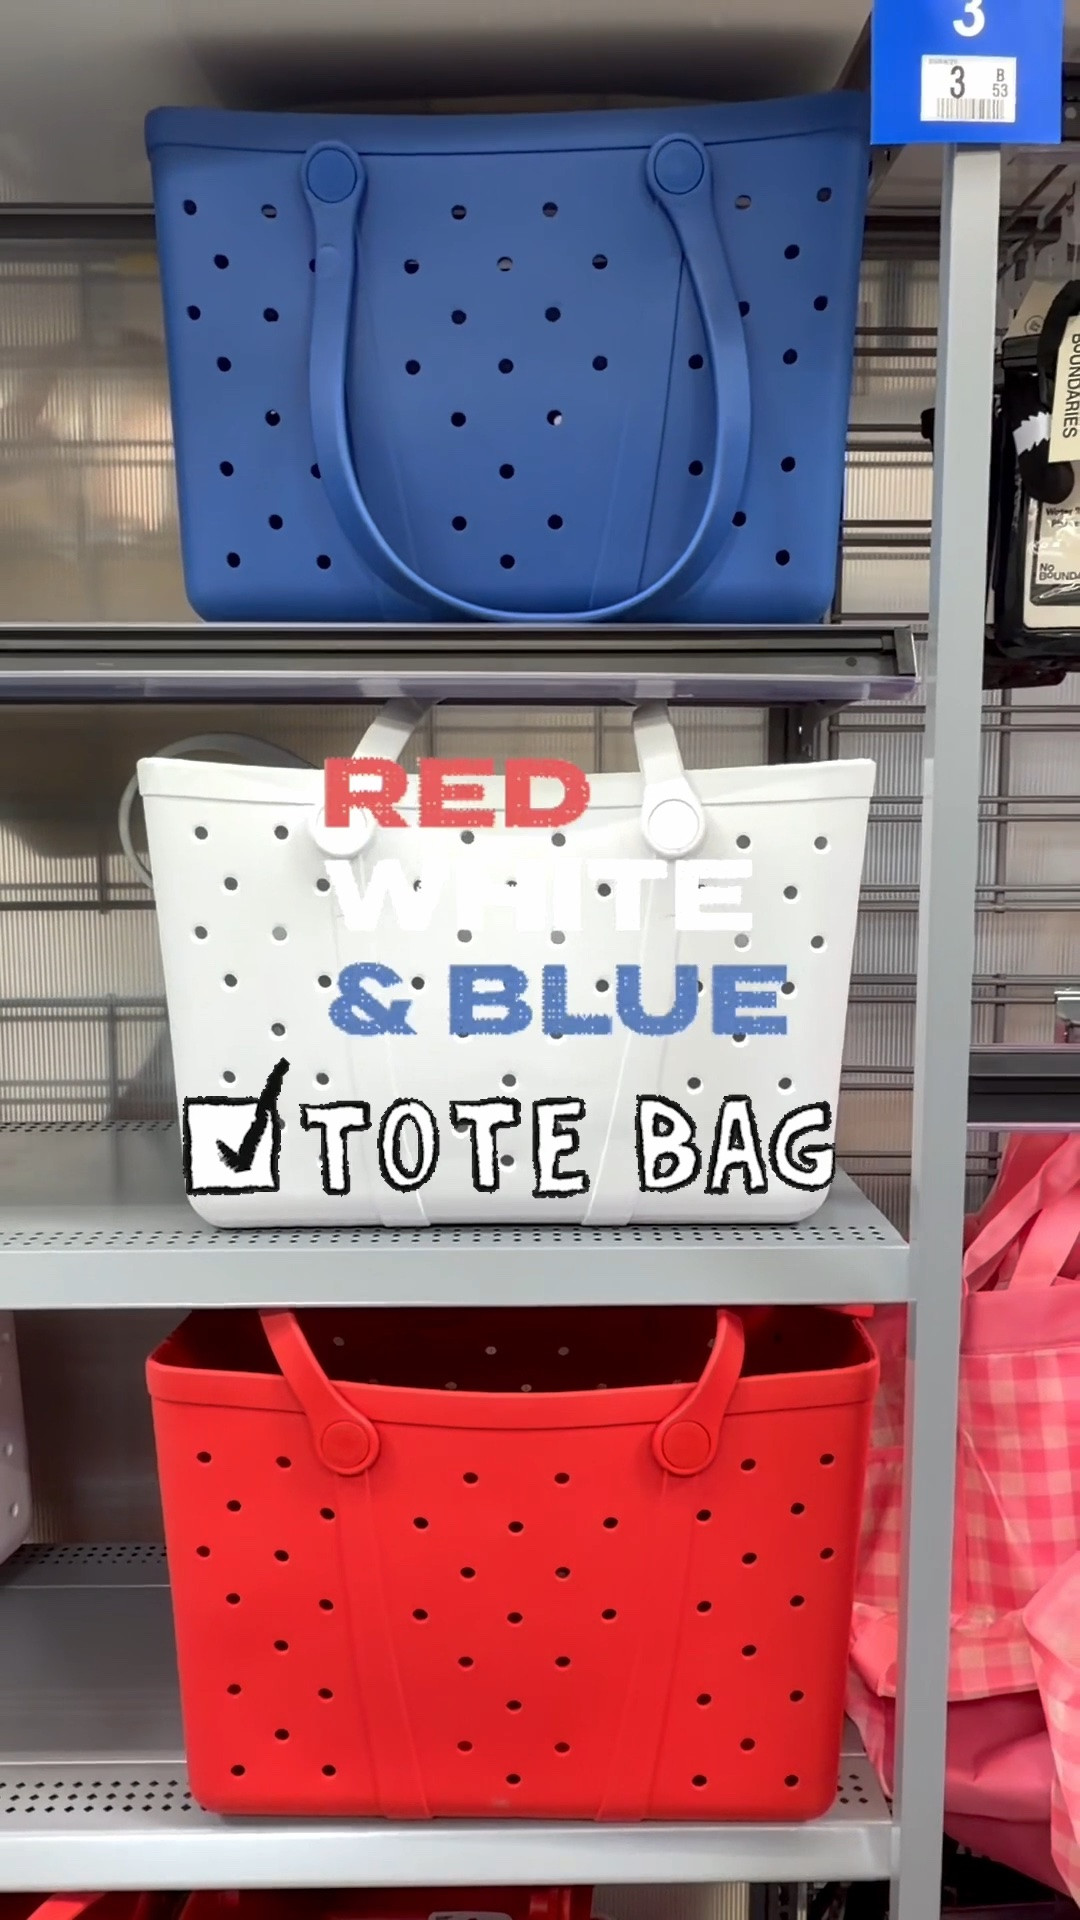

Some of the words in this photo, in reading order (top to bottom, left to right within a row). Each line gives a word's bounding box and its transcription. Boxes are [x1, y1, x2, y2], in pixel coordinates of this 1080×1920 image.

[952, 0, 985, 37] 3
[950, 65, 965, 99] 3
[996, 69, 1005, 82] B
[992, 83, 1008, 97] 53
